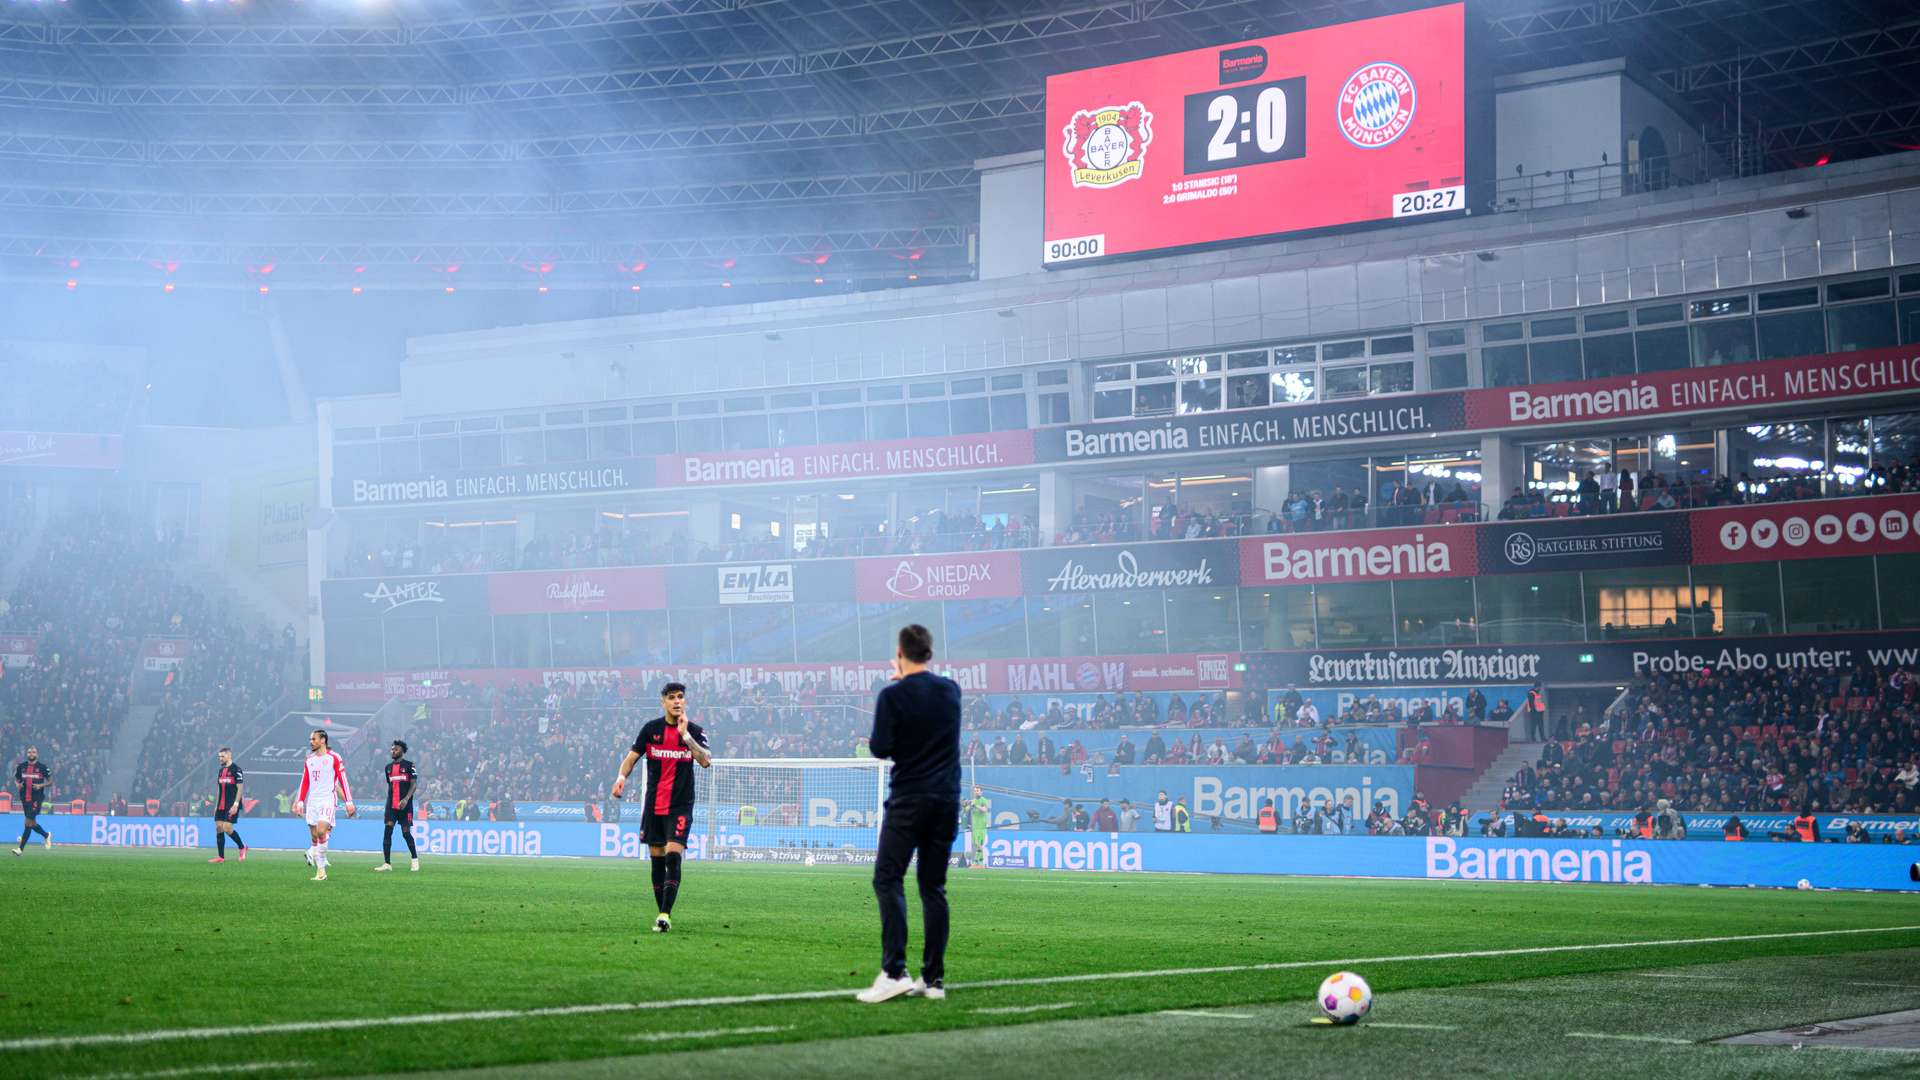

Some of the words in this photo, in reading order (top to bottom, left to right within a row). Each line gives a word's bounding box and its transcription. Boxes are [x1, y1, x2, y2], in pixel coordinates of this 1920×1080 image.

[1223, 54, 1263, 69] Barmenia
[1344, 83, 1358, 104] FC
[1359, 67, 1410, 96] BAYERN
[1098, 113, 1118, 124] 1904
[1208, 87, 1287, 161] 2:0
[1344, 109, 1410, 144] MÜNCHEN
[1090, 141, 1124, 153] BAYER
[1079, 165, 1135, 182] Leverkusen
[1172, 182, 1183, 191] 1:0
[1183, 176, 1220, 190] STANISIC
[1401, 190, 1456, 213] 20:27
[1051, 239, 1098, 259] 90:00
[1509, 380, 1659, 422] Barmenia
[1671, 373, 1776, 407] EINFACH.
[1065, 422, 1189, 457] Barmenia
[1200, 419, 1286, 448] EINFACH.
[1293, 407, 1432, 439] MENSCHLICH.
[685, 452, 794, 482] Barmenia
[804, 453, 881, 476] EINFACH.
[886, 443, 1004, 470] MENSCHLICH.
[353, 475, 448, 502] Barmenia
[455, 475, 520, 497] EINFACH.
[526, 468, 629, 492] MENSCHLICH.
[1510, 541, 1532, 560] RS
[1537, 539, 1597, 553] RATGEBER
[1601, 534, 1663, 550] STIFTUNG
[1048, 551, 1213, 591] Alexanderwerk
[1263, 534, 1451, 581] Barmenia
[723, 564, 789, 593] EMKA
[927, 563, 991, 583] NIEDAX
[927, 584, 970, 598] GROUP
[1441, 649, 1541, 682] Anzeiger
[1633, 647, 1767, 673] Probe-Abo
[1776, 649, 1853, 669] unter:
[651, 745, 692, 759] Barmenia
[92, 810, 199, 848] Barmenia
[676, 815, 687, 831] 3
[413, 820, 541, 856] Barmenia
[1426, 836, 1653, 884] Barmenia
